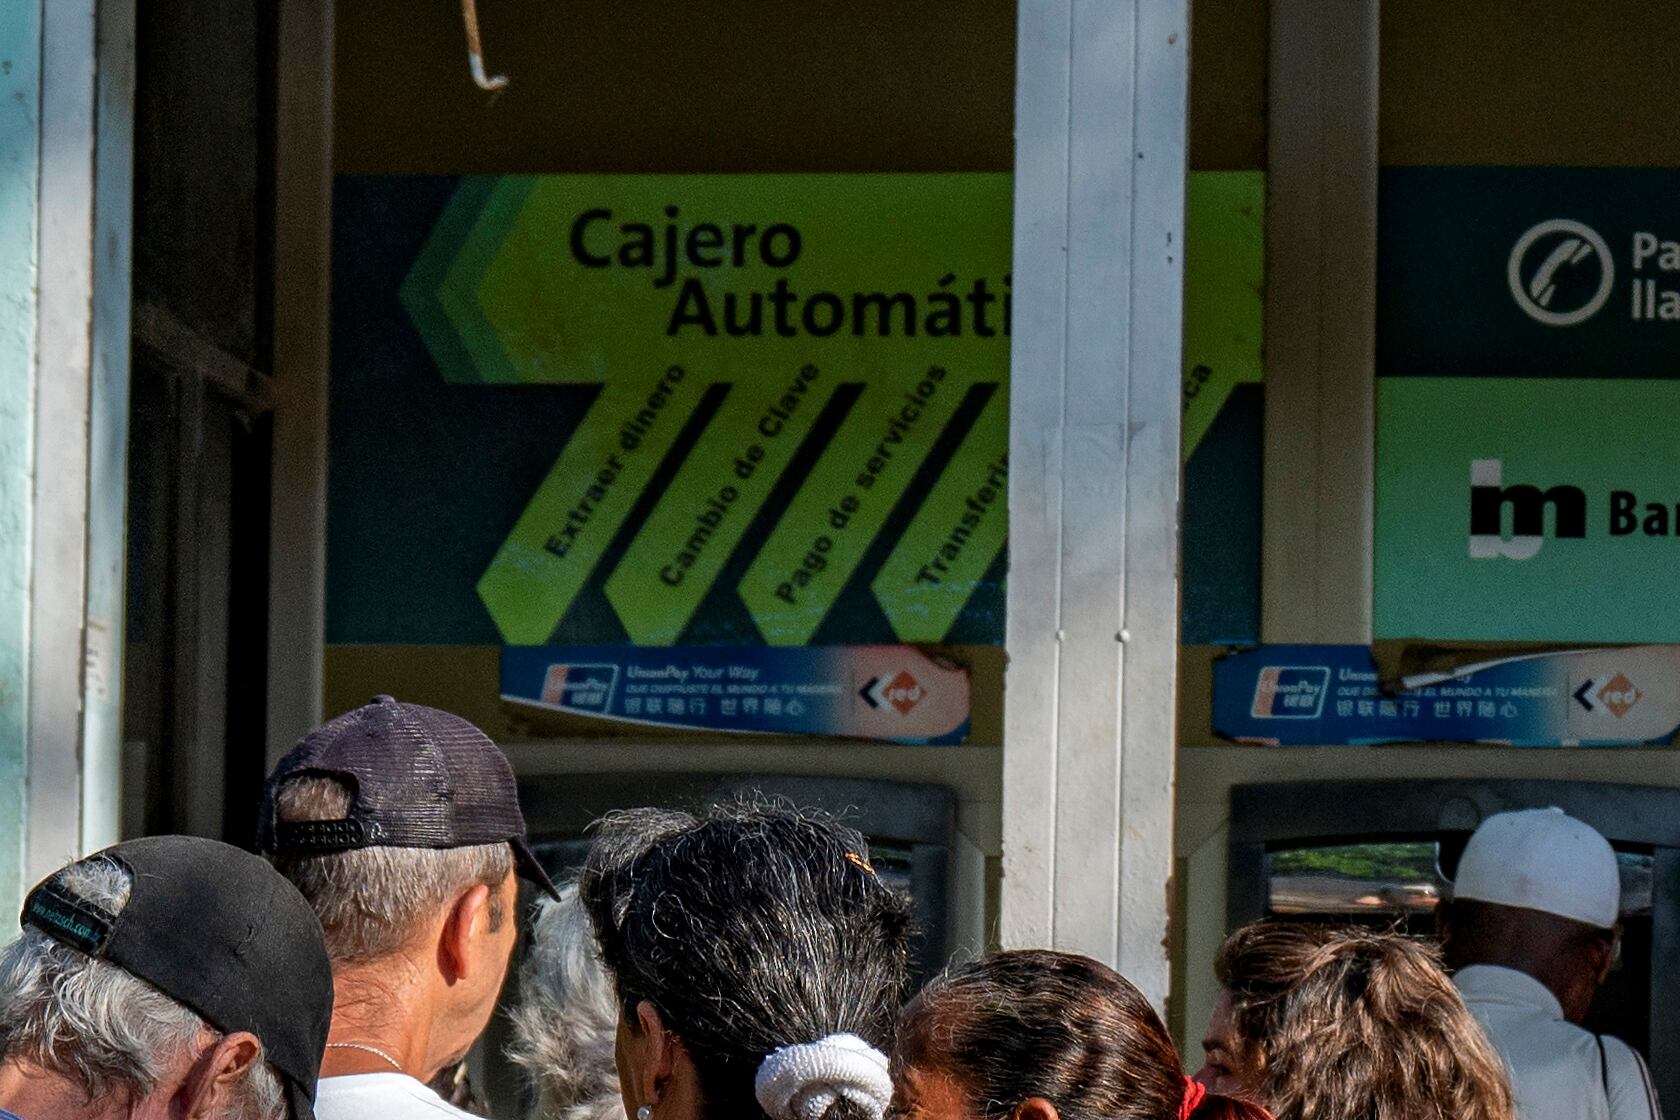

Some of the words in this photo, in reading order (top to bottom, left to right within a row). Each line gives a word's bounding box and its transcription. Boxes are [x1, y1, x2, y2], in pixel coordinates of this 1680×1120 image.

[570, 205, 801, 288] Cajero
[665, 272, 1012, 337] Automáti
[544, 455, 624, 559] Extraer
[618, 364, 686, 451] dinero
[659, 485, 739, 587] Cambio
[734, 444, 765, 480] de
[758, 363, 820, 438] Clave
[775, 535, 833, 604] Pago
[828, 495, 860, 530] de
[856, 364, 947, 490] servicios
[691, 665, 726, 680] Your
[728, 665, 760, 682] Way
[888, 684, 920, 703] red
[1604, 689, 1636, 707] red
